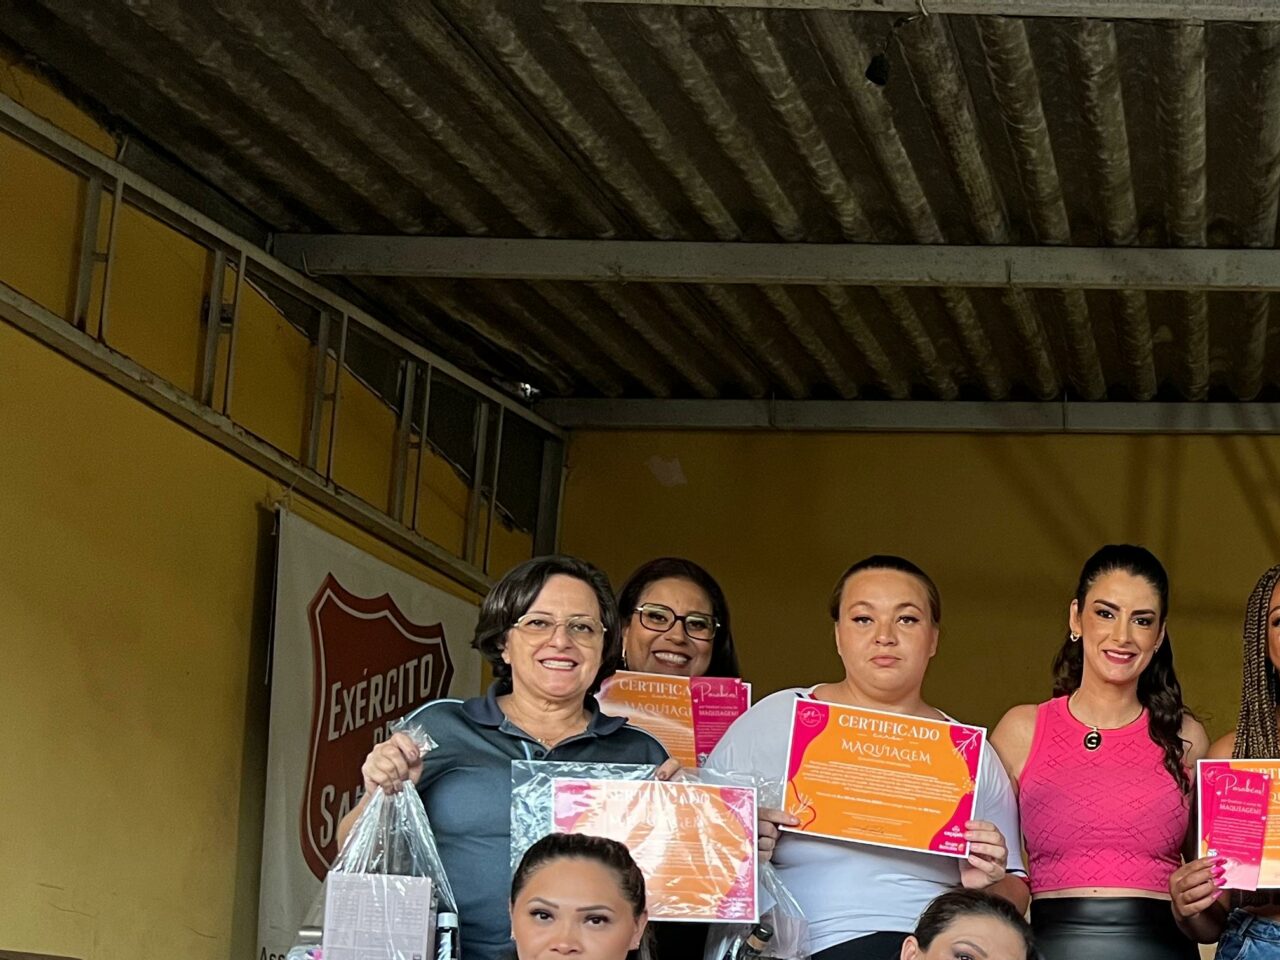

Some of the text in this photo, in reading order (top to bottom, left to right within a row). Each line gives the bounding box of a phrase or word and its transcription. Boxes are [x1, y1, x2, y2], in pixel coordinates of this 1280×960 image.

[327, 653, 434, 742] EXÉRCITO
[619, 679, 692, 696] CERTIFICA
[838, 713, 940, 741] CERTIFICADO
[841, 738, 932, 765] MAQUIAGEM
